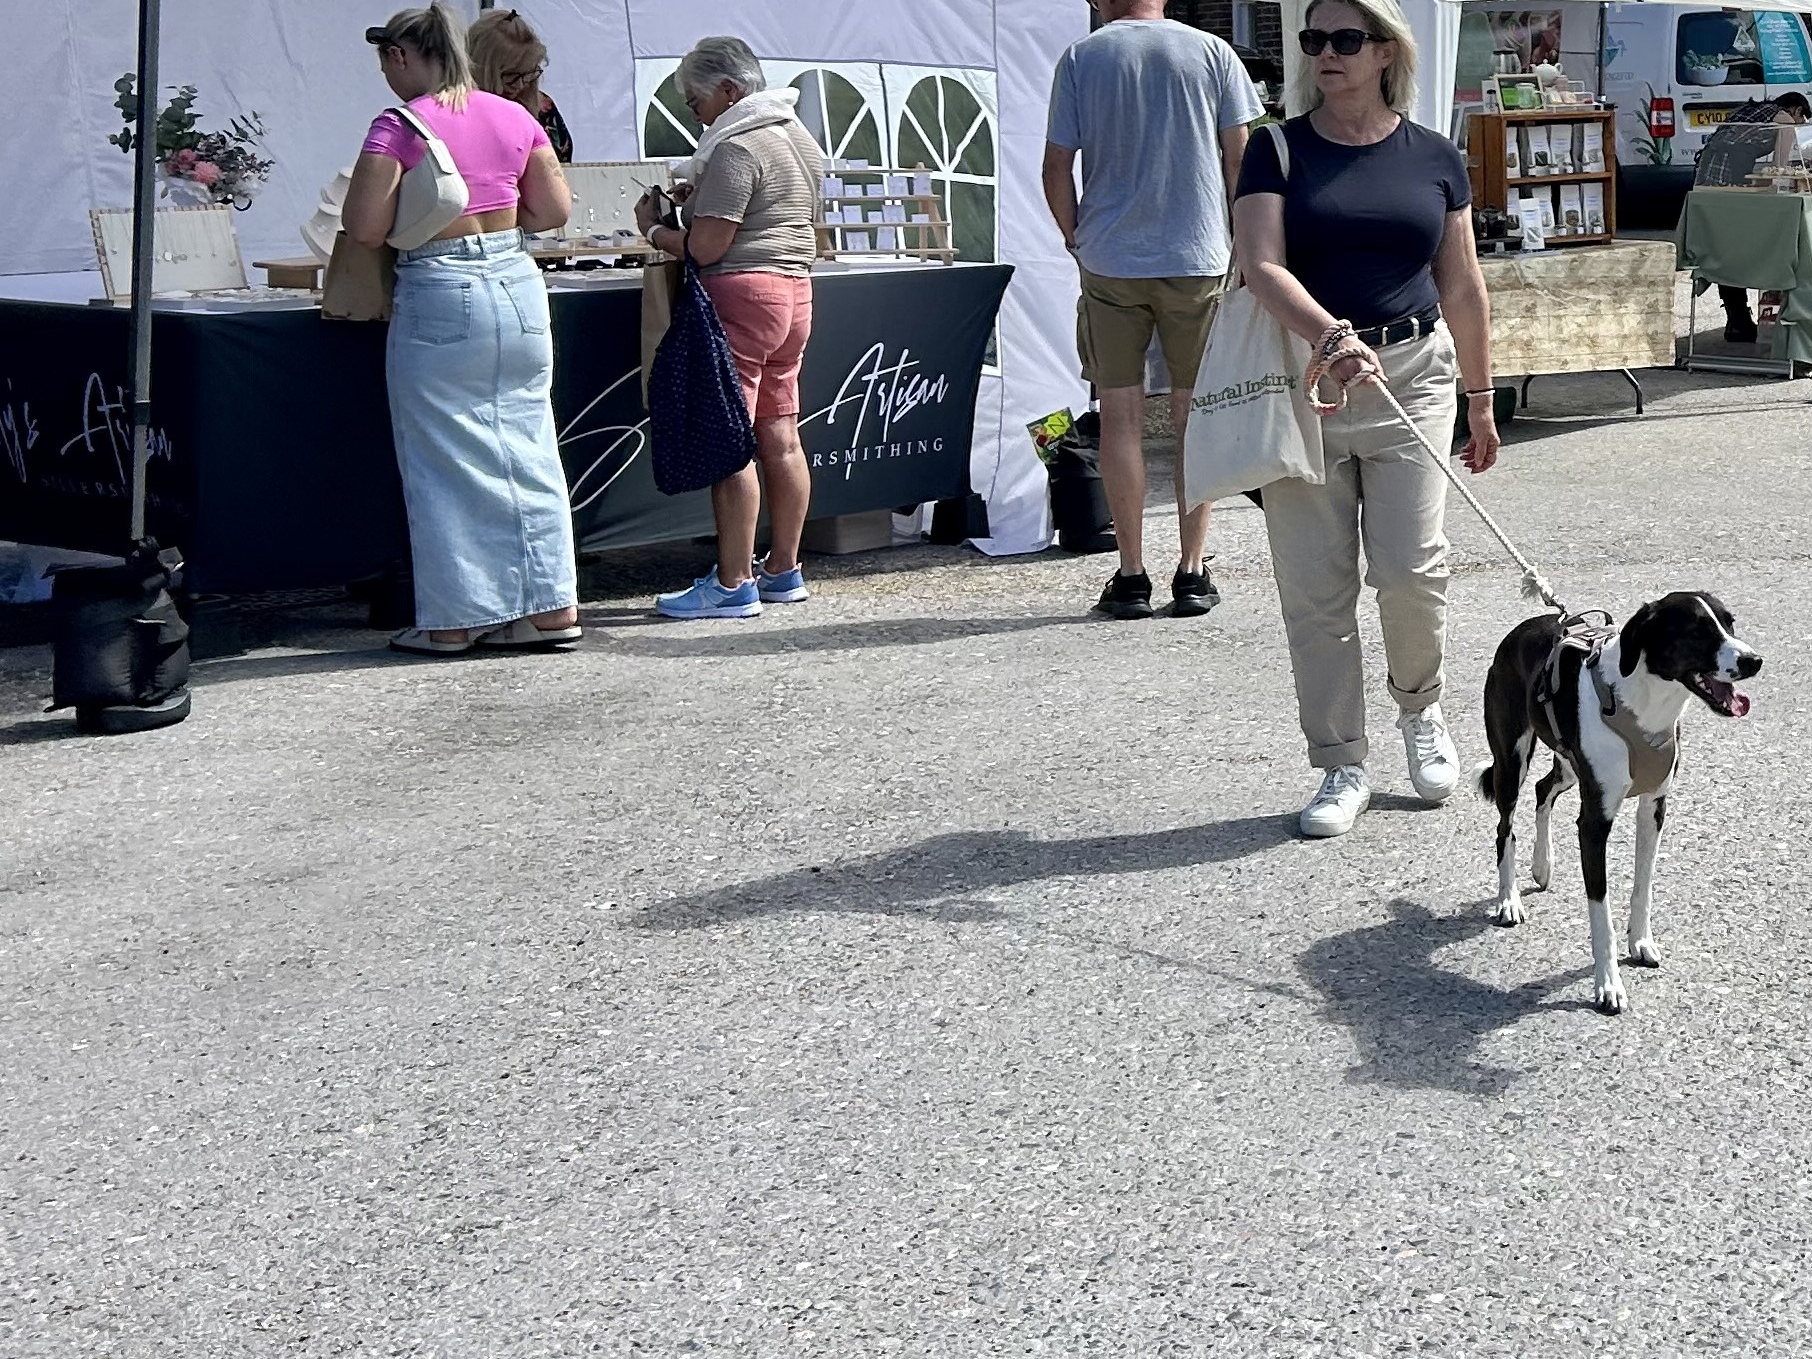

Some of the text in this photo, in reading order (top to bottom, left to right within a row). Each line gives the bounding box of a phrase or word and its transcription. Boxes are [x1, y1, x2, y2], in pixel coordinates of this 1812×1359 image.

[1246, 373, 1297, 394] Instint
[797, 342, 949, 480] Artisan
[812, 437, 944, 468] RSMITHING
